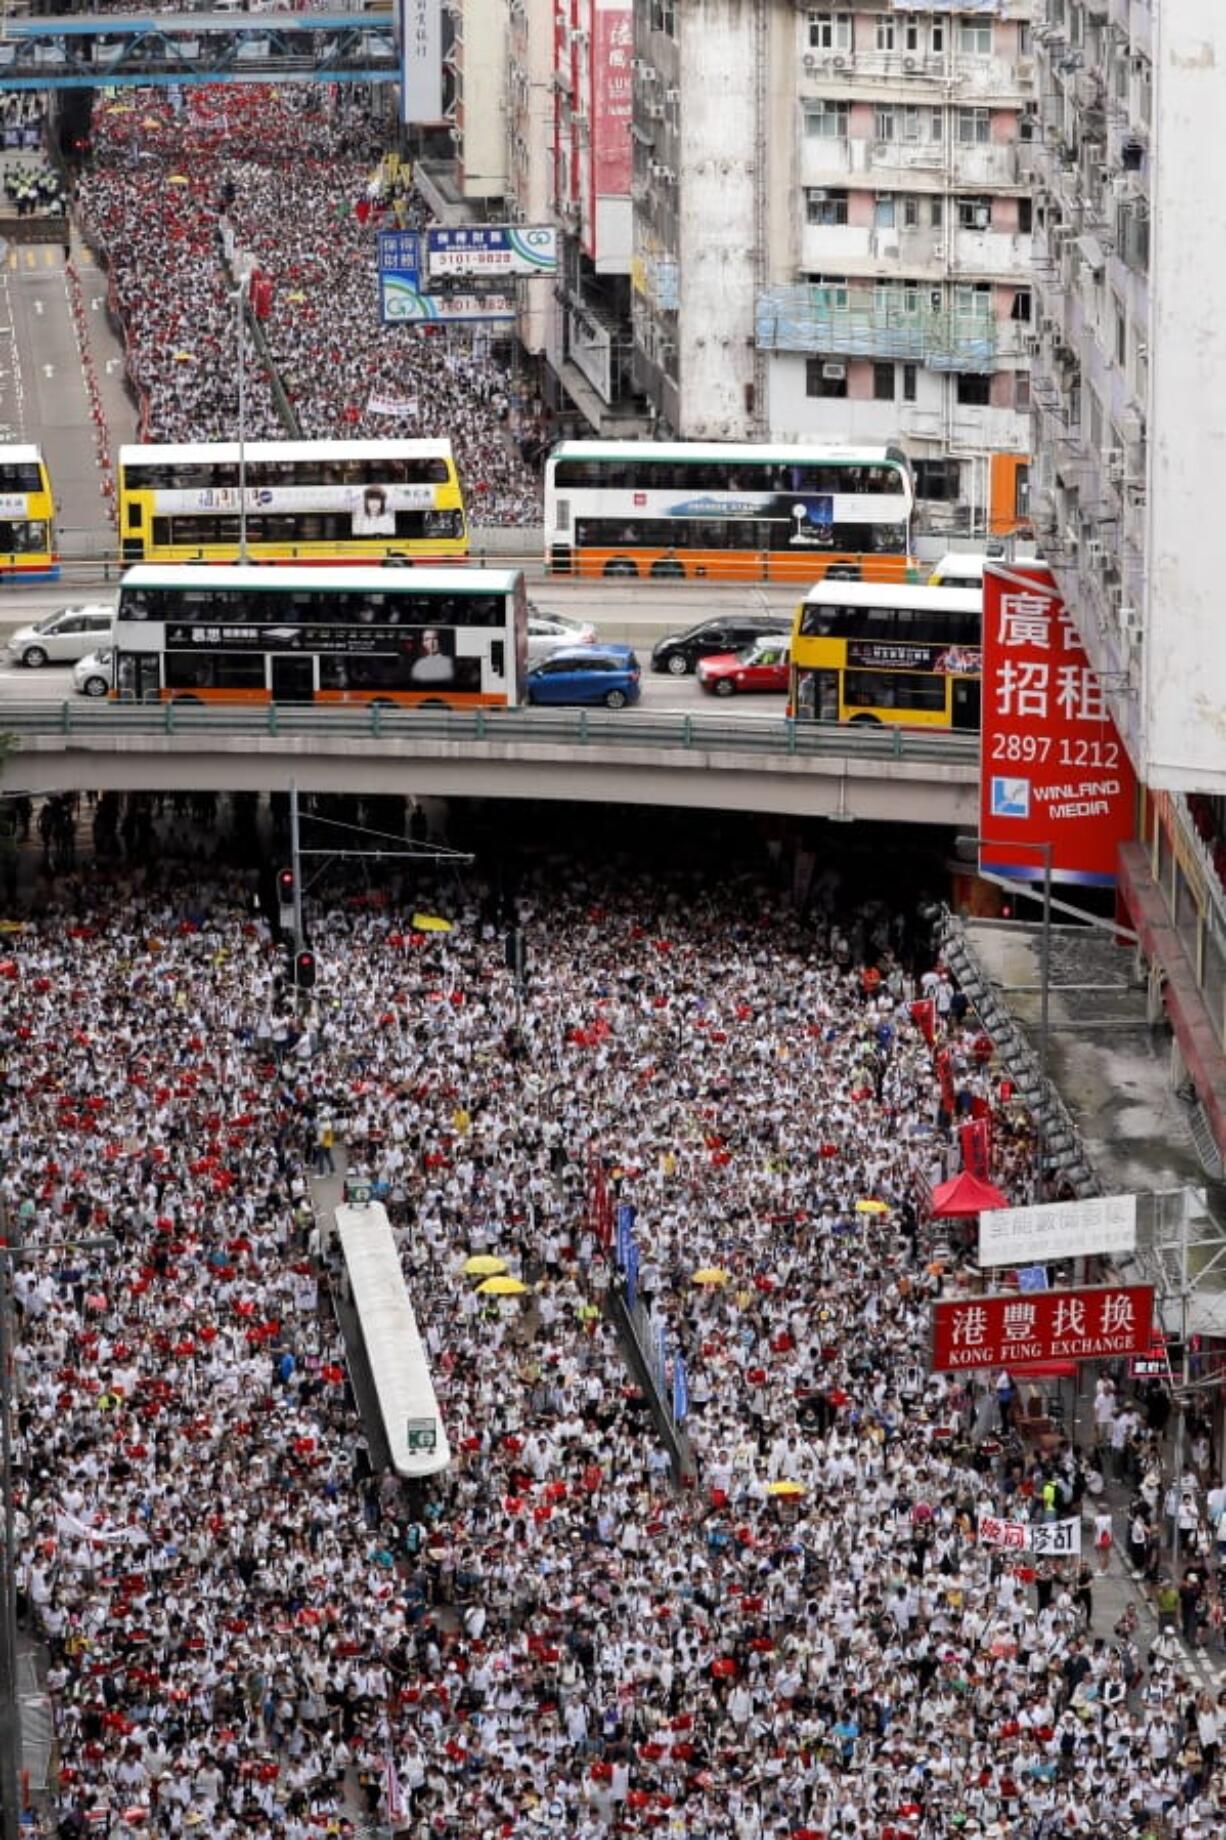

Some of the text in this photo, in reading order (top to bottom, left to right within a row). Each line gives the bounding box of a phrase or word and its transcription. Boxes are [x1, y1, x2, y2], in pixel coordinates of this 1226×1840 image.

[996, 659, 1111, 722] 招租
[992, 733, 1119, 769] 2897 1212
[1033, 780, 1120, 800] WINLAND
[1049, 800, 1110, 819] MEDIA
[952, 1294, 1137, 1346] 港豐找換
[949, 1334, 1136, 1365] KONG FUNG EXCHANGE
